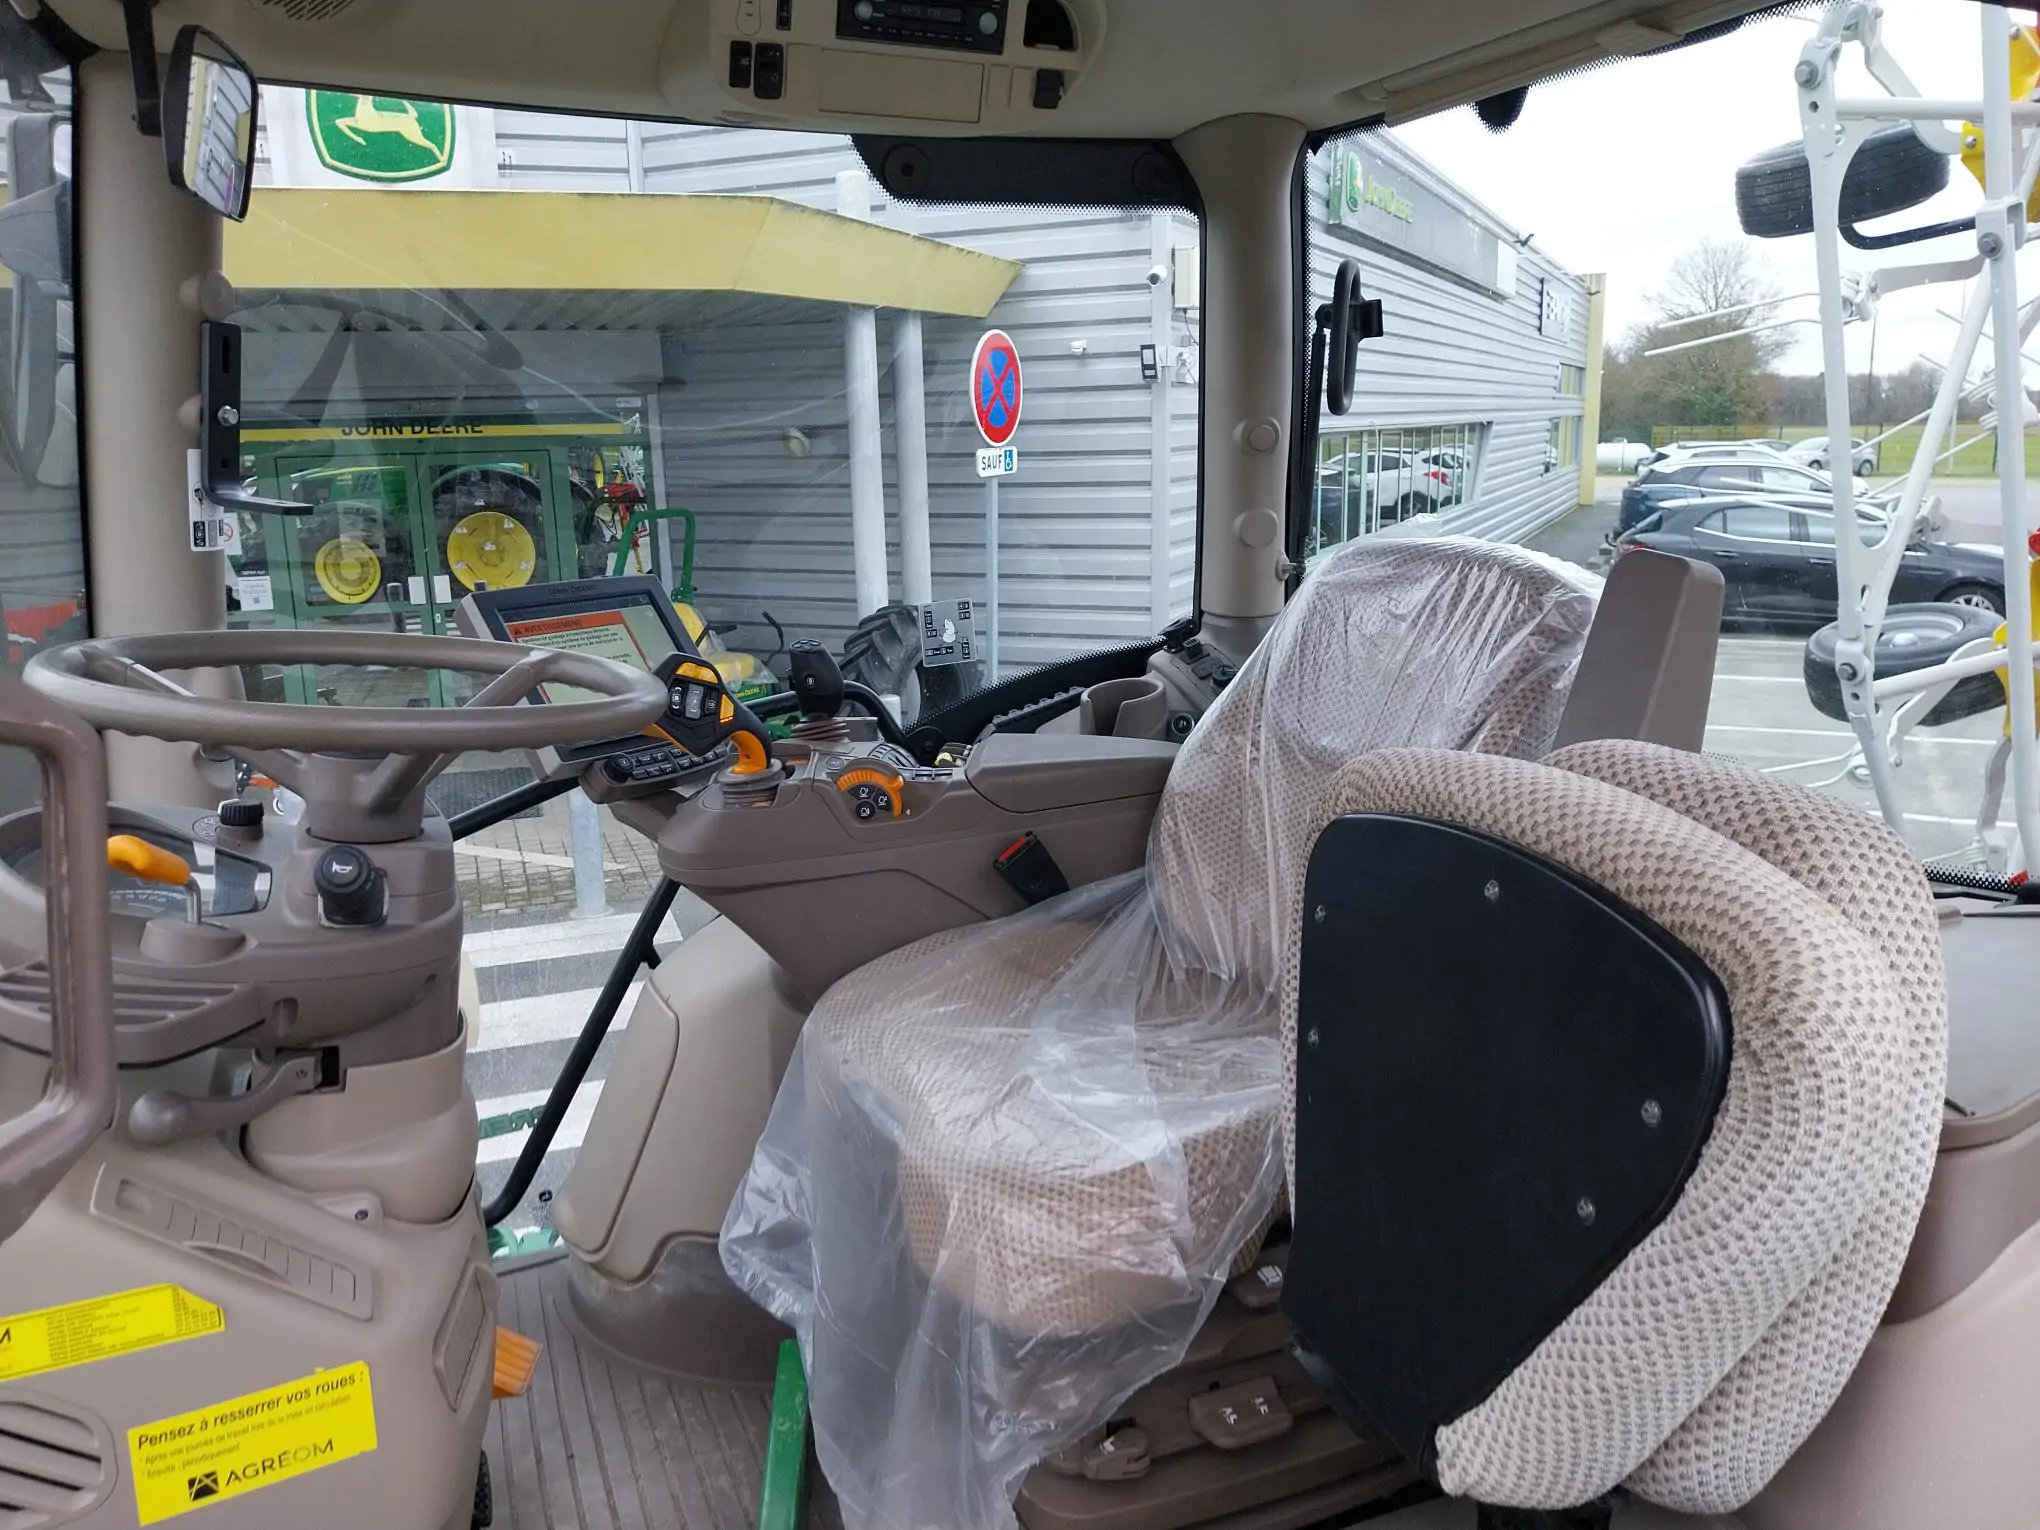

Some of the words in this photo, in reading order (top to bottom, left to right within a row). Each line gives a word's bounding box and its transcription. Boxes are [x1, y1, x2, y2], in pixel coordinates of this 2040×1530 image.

[341, 417, 404, 436] JOHN
[411, 416, 483, 435] DEERE
[981, 453, 1003, 471] SAUF
[138, 1423, 195, 1450] Pensez
[200, 1416, 208, 1431] à
[214, 1396, 282, 1429] resserrer
[287, 1387, 311, 1404] vos
[316, 1373, 356, 1396] roues
[225, 1437, 334, 1488] AGRÉOM
